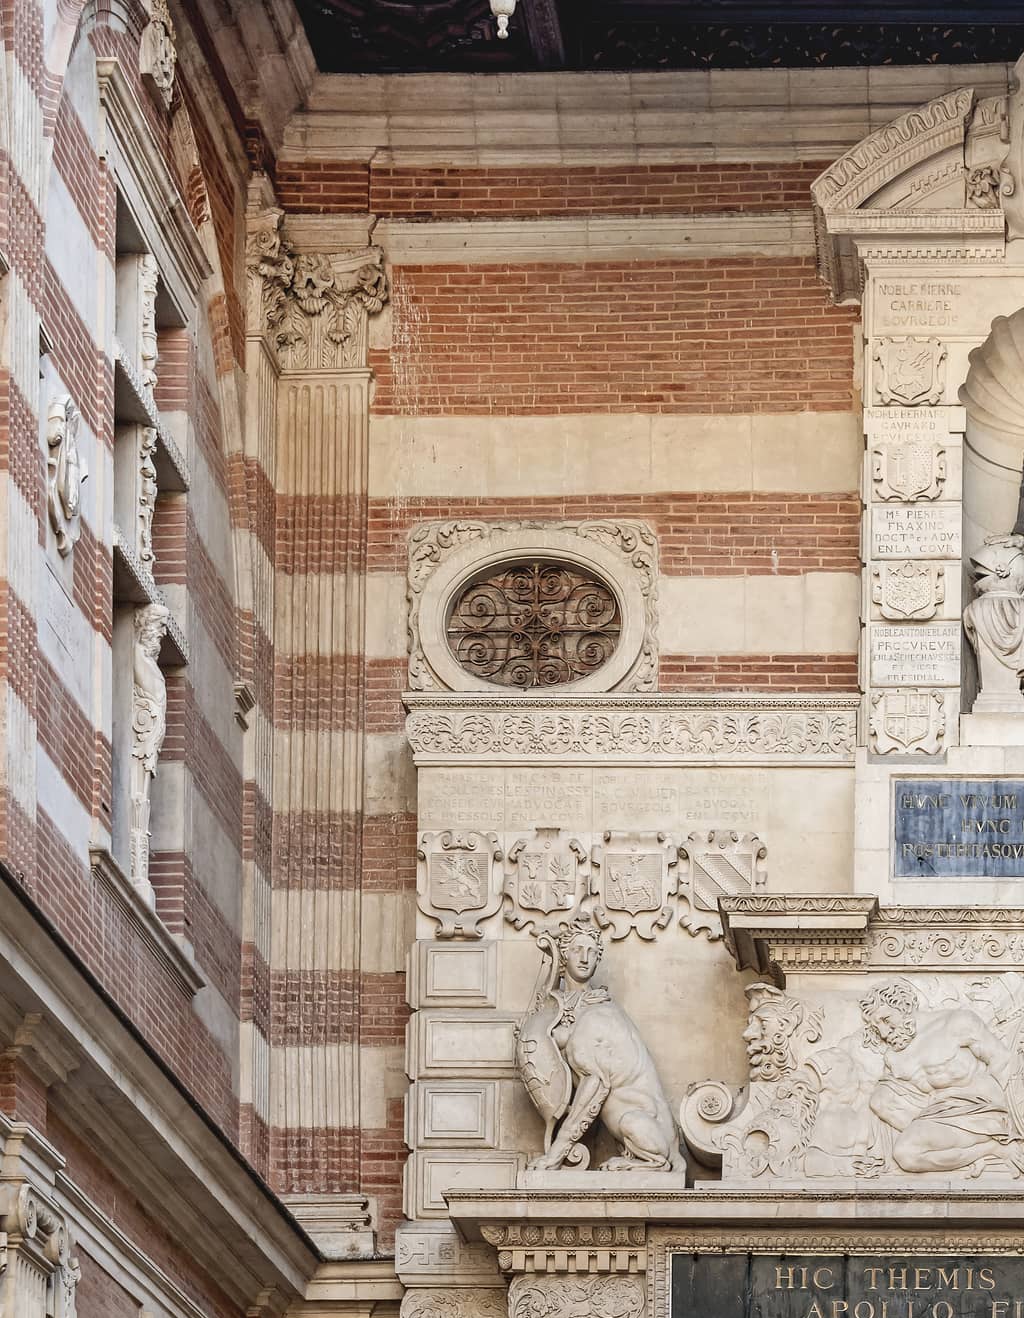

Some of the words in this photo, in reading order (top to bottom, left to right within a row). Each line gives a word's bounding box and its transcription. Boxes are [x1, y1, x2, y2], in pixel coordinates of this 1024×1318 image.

[962, 819, 1010, 833] HVNC
[774, 1267, 835, 1290] HIC
[863, 1267, 996, 1291] THEMIS
